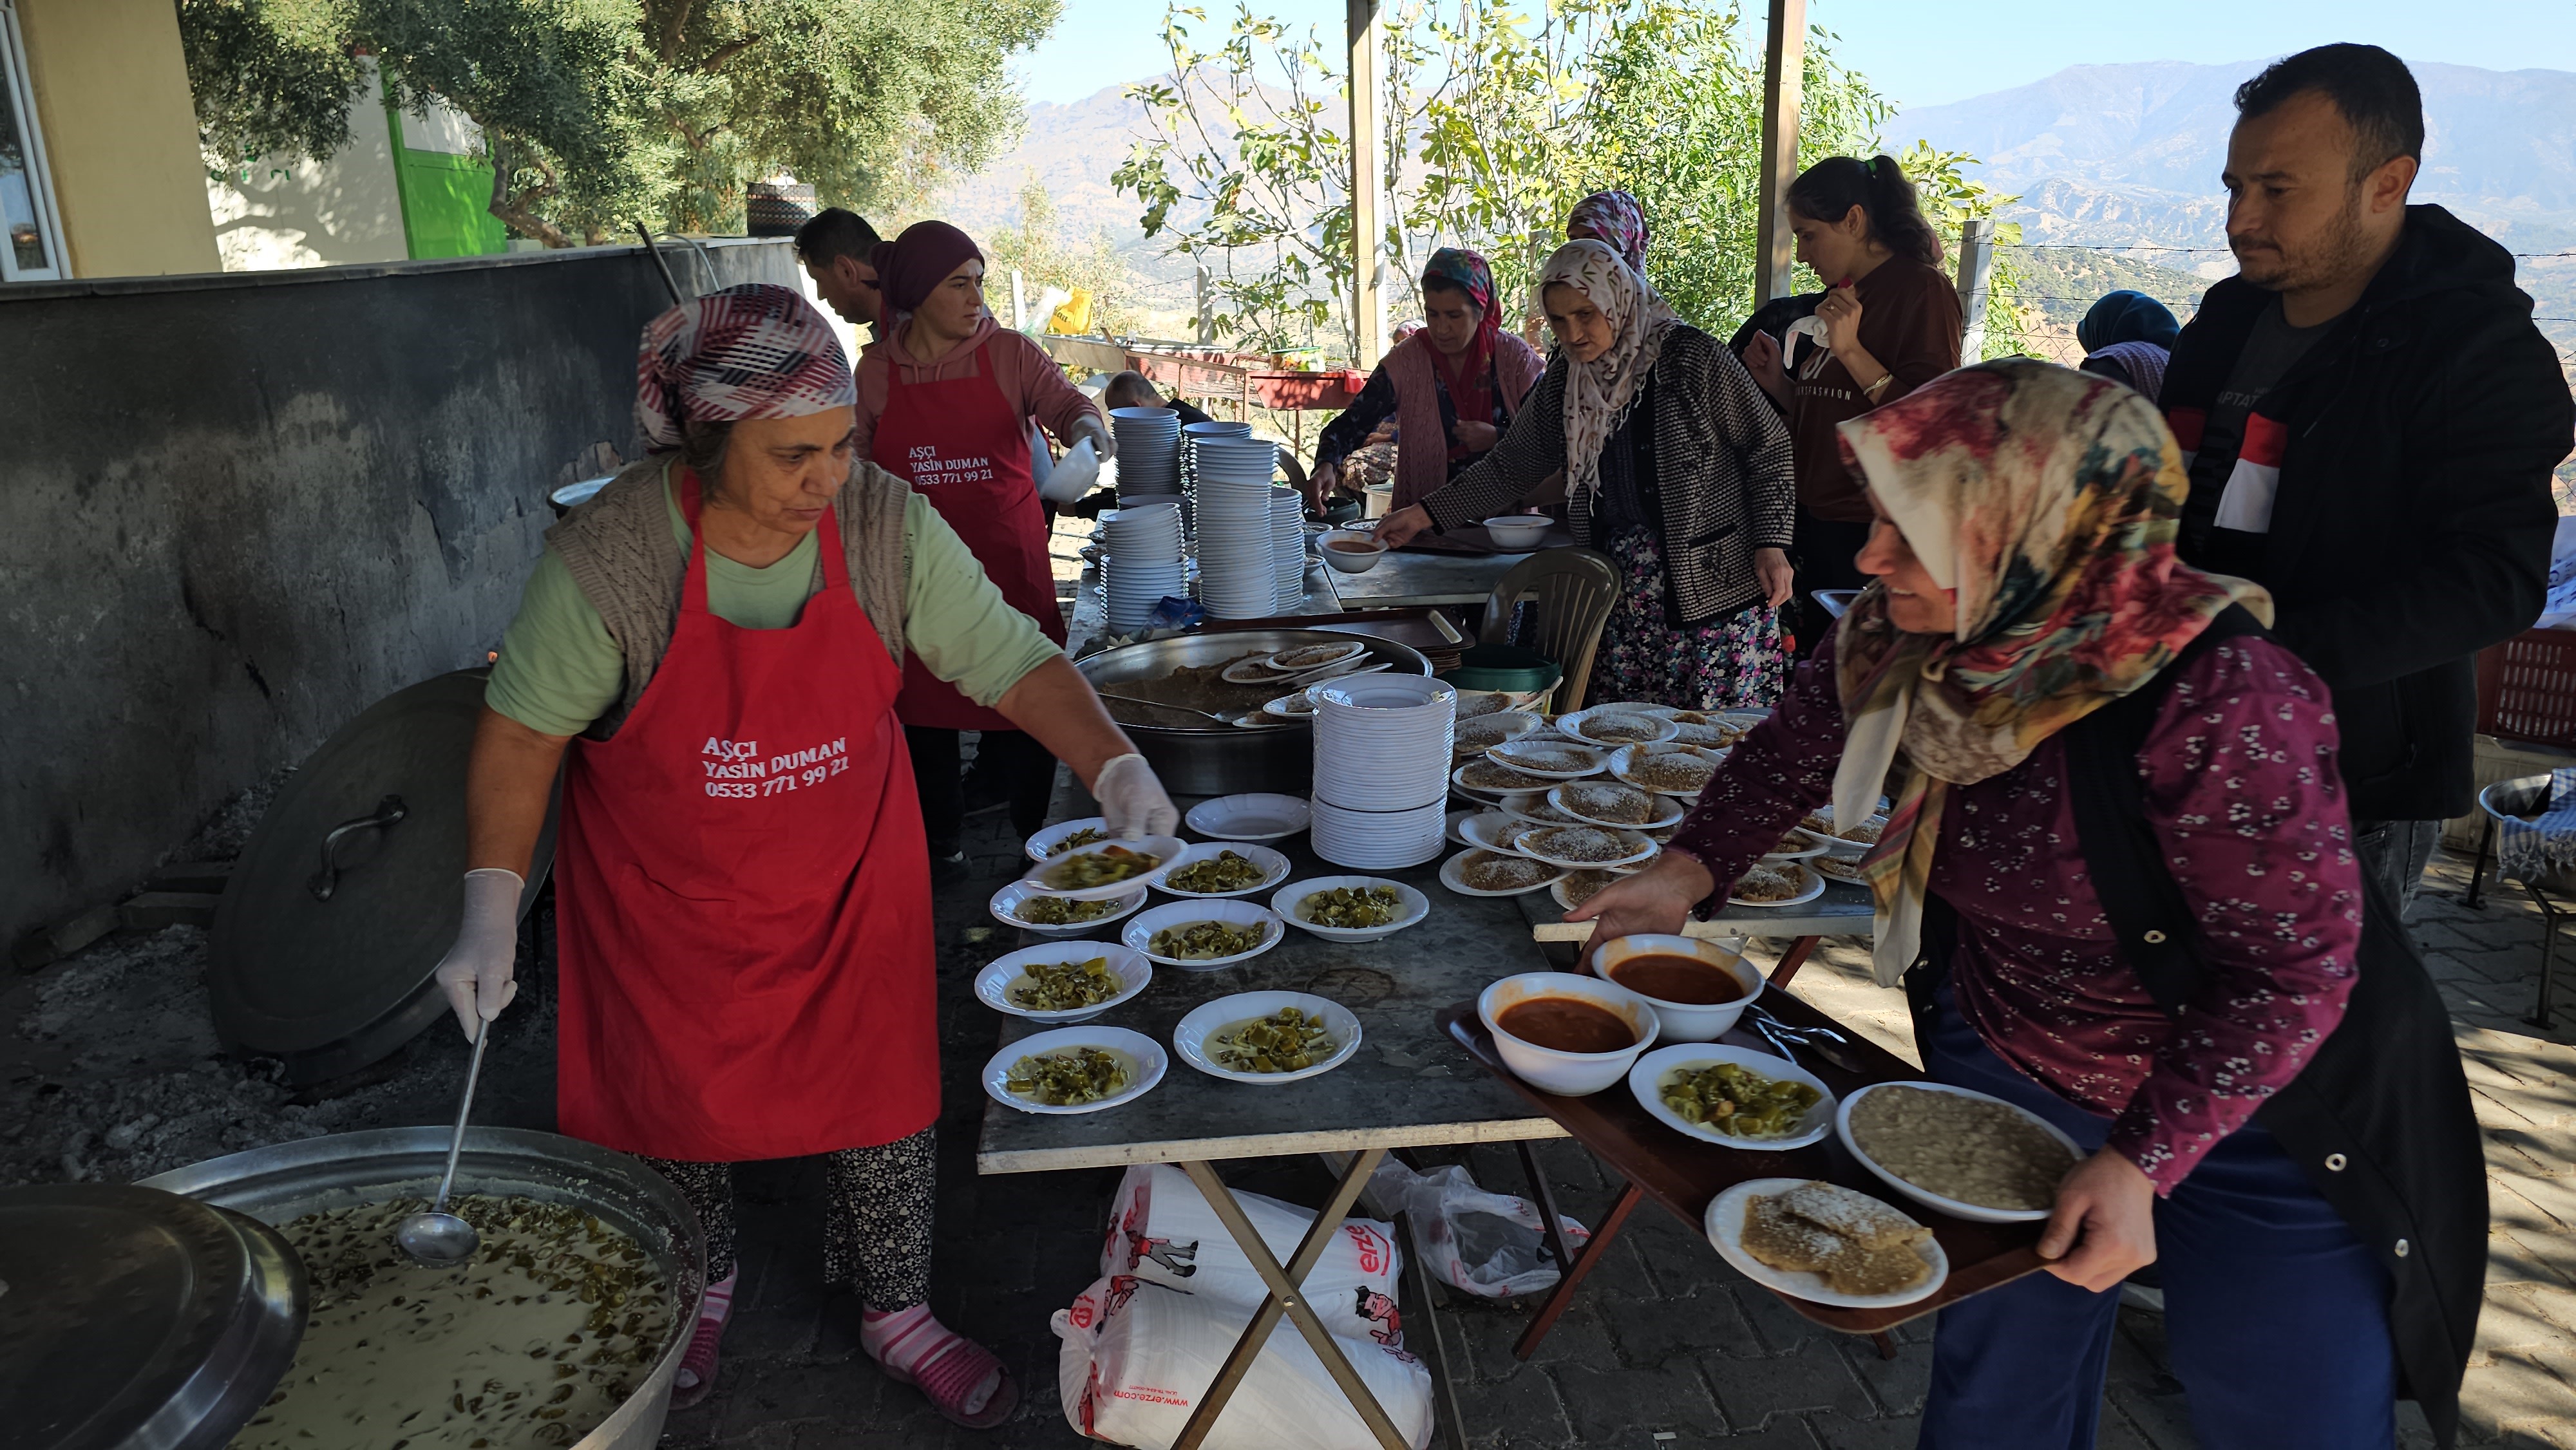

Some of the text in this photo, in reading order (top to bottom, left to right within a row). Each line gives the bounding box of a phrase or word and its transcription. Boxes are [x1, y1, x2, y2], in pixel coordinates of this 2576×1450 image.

[909, 446, 936, 460] AŞÇI
[910, 457, 989, 473] YASİN DUMAN
[914, 469, 994, 485] 0533 771 99 21
[702, 737, 758, 762] AŞÇI
[702, 737, 846, 778] YASİN DUMAN
[705, 757, 849, 798] 0533 771 99 21
[1345, 1225, 1379, 1273] erze
[1114, 1391, 1188, 1406] www.erze.com
